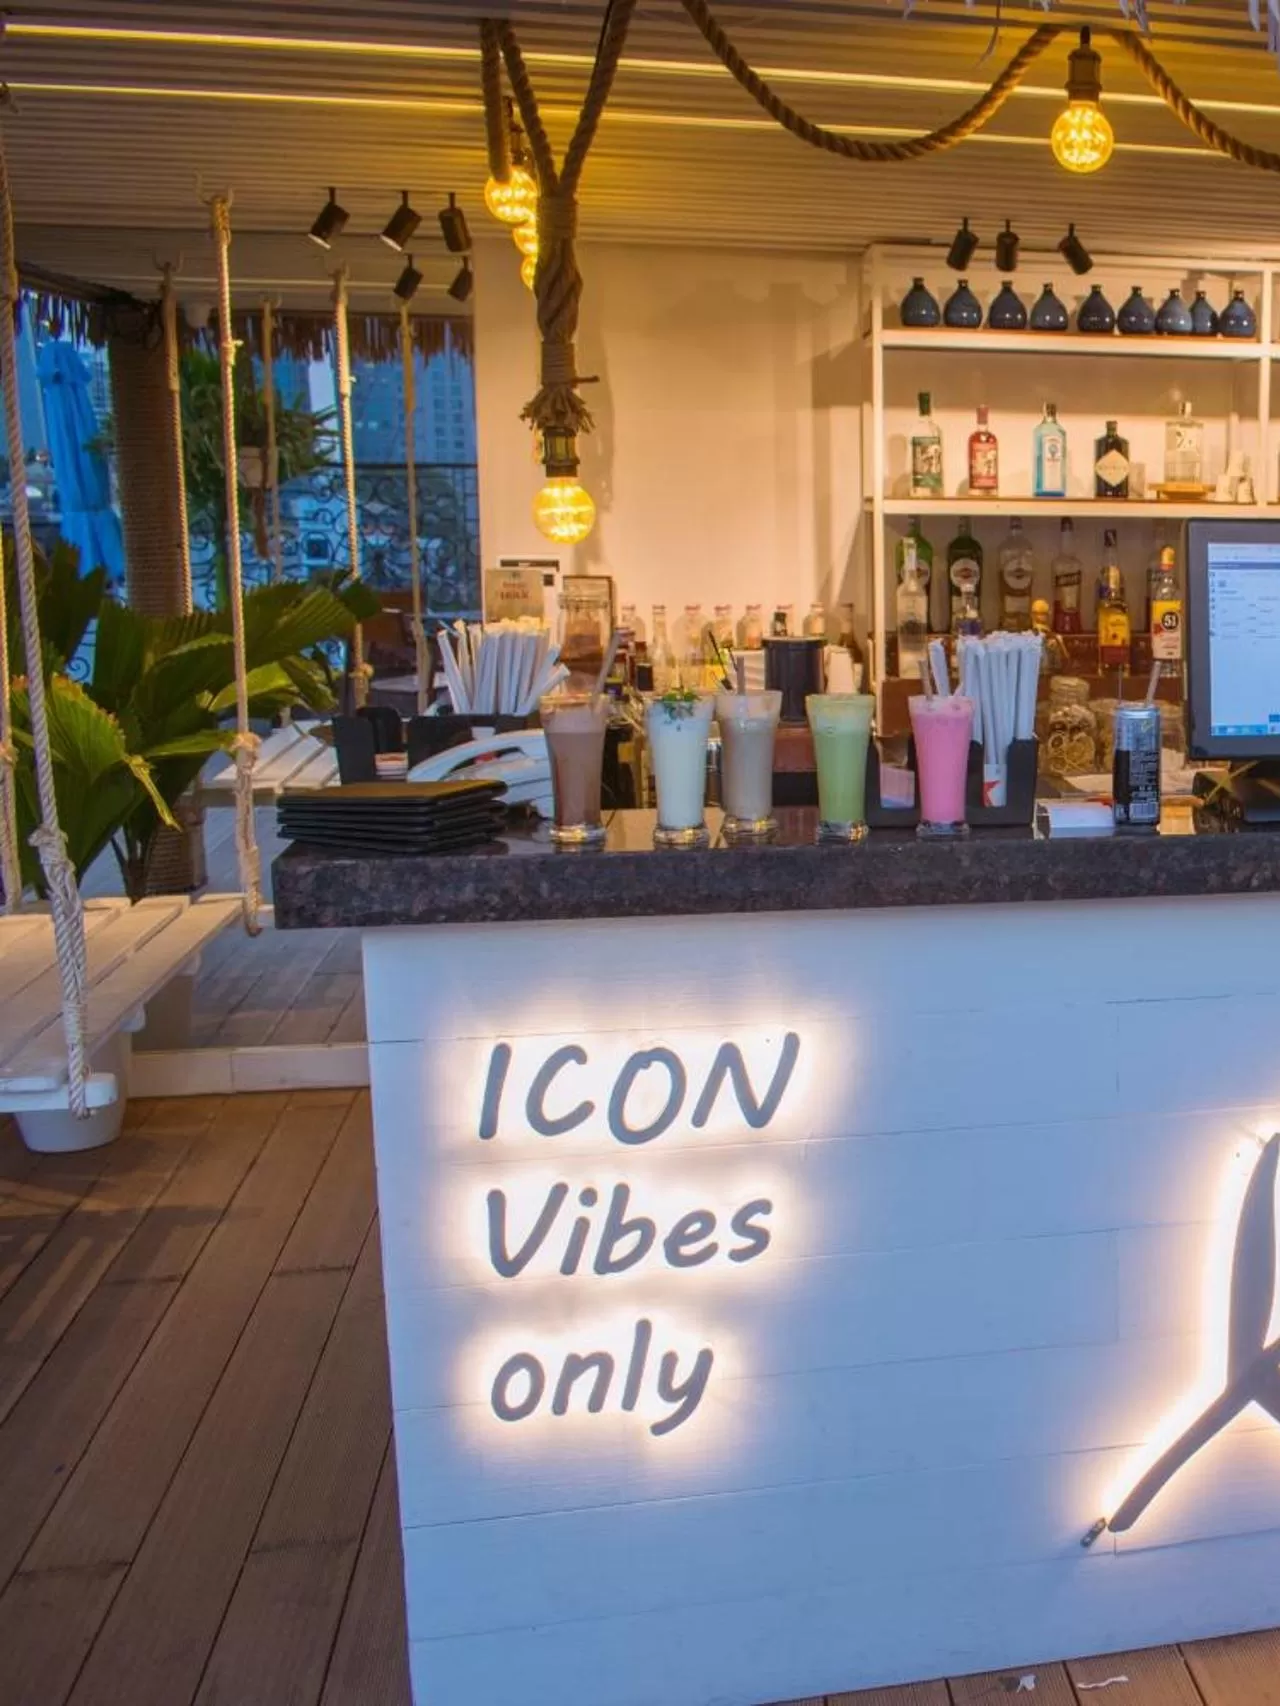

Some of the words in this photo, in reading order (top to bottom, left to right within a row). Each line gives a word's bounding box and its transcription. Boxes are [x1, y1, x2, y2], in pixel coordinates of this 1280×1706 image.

[1164, 614, 1177, 627] 51
[479, 1032, 800, 1145] ICON
[487, 1182, 773, 1278] Vibes
[491, 1318, 714, 1436] only
